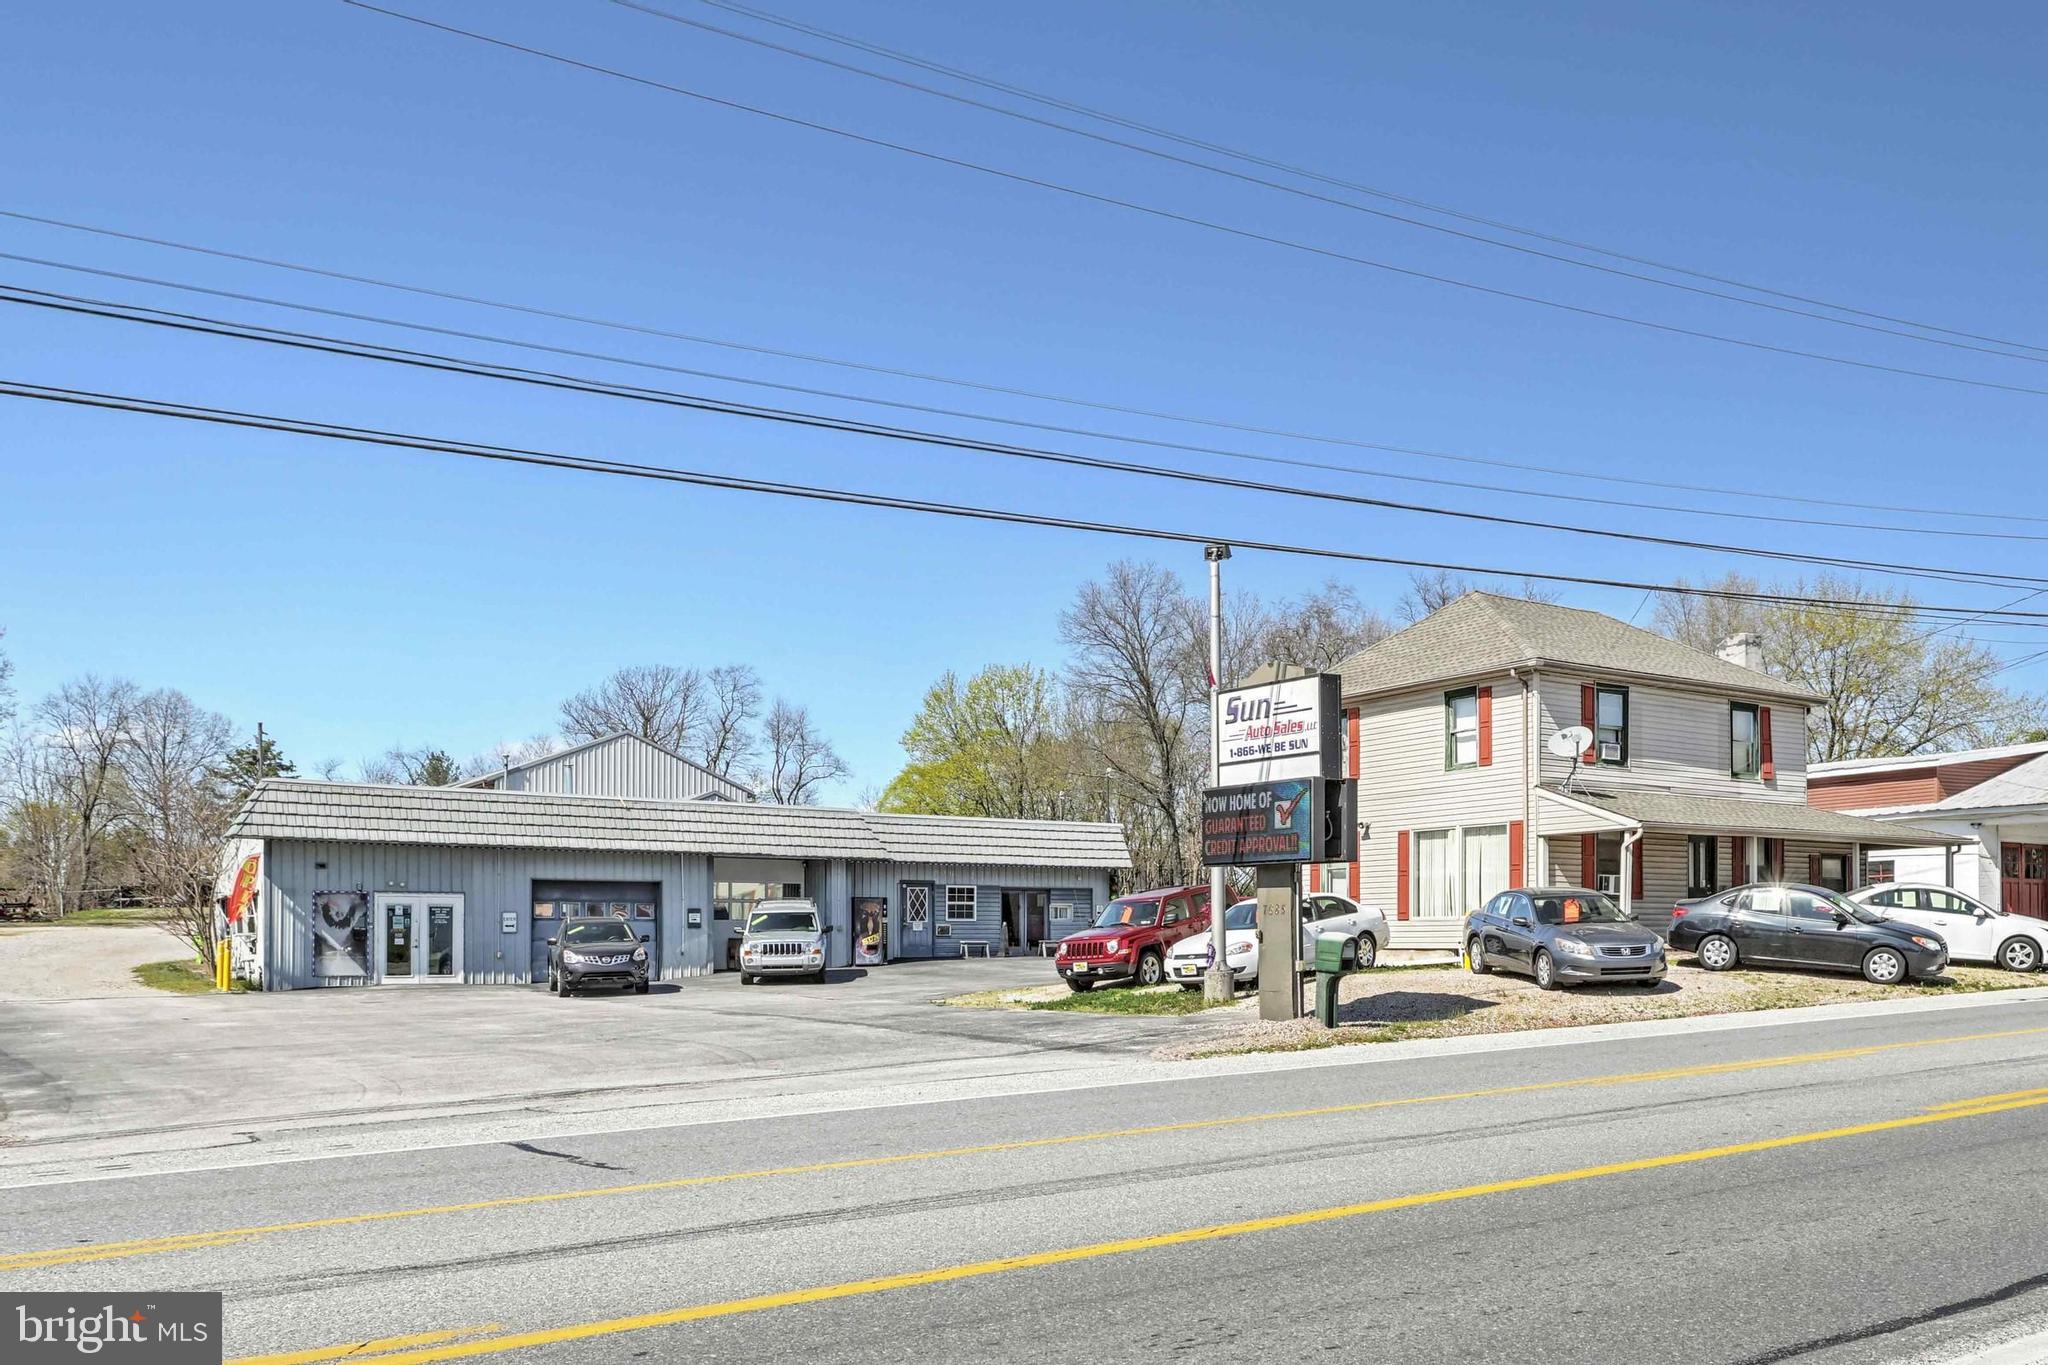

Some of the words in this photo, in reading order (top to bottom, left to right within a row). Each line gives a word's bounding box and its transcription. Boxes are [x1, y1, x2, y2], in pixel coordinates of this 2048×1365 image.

[1225, 696, 1272, 725] Sun
[1245, 724, 1272, 740] Auto
[1273, 719, 1304, 735] Sales
[1274, 741, 1286, 752] BE
[1289, 738, 1308, 751] SUN
[1204, 796, 1227, 813] NOW
[1229, 792, 1257, 811] HOME
[1260, 791, 1273, 808] OF
[1205, 814, 1266, 835] GUARANTEED
[1205, 839, 1235, 856] CREDIT
